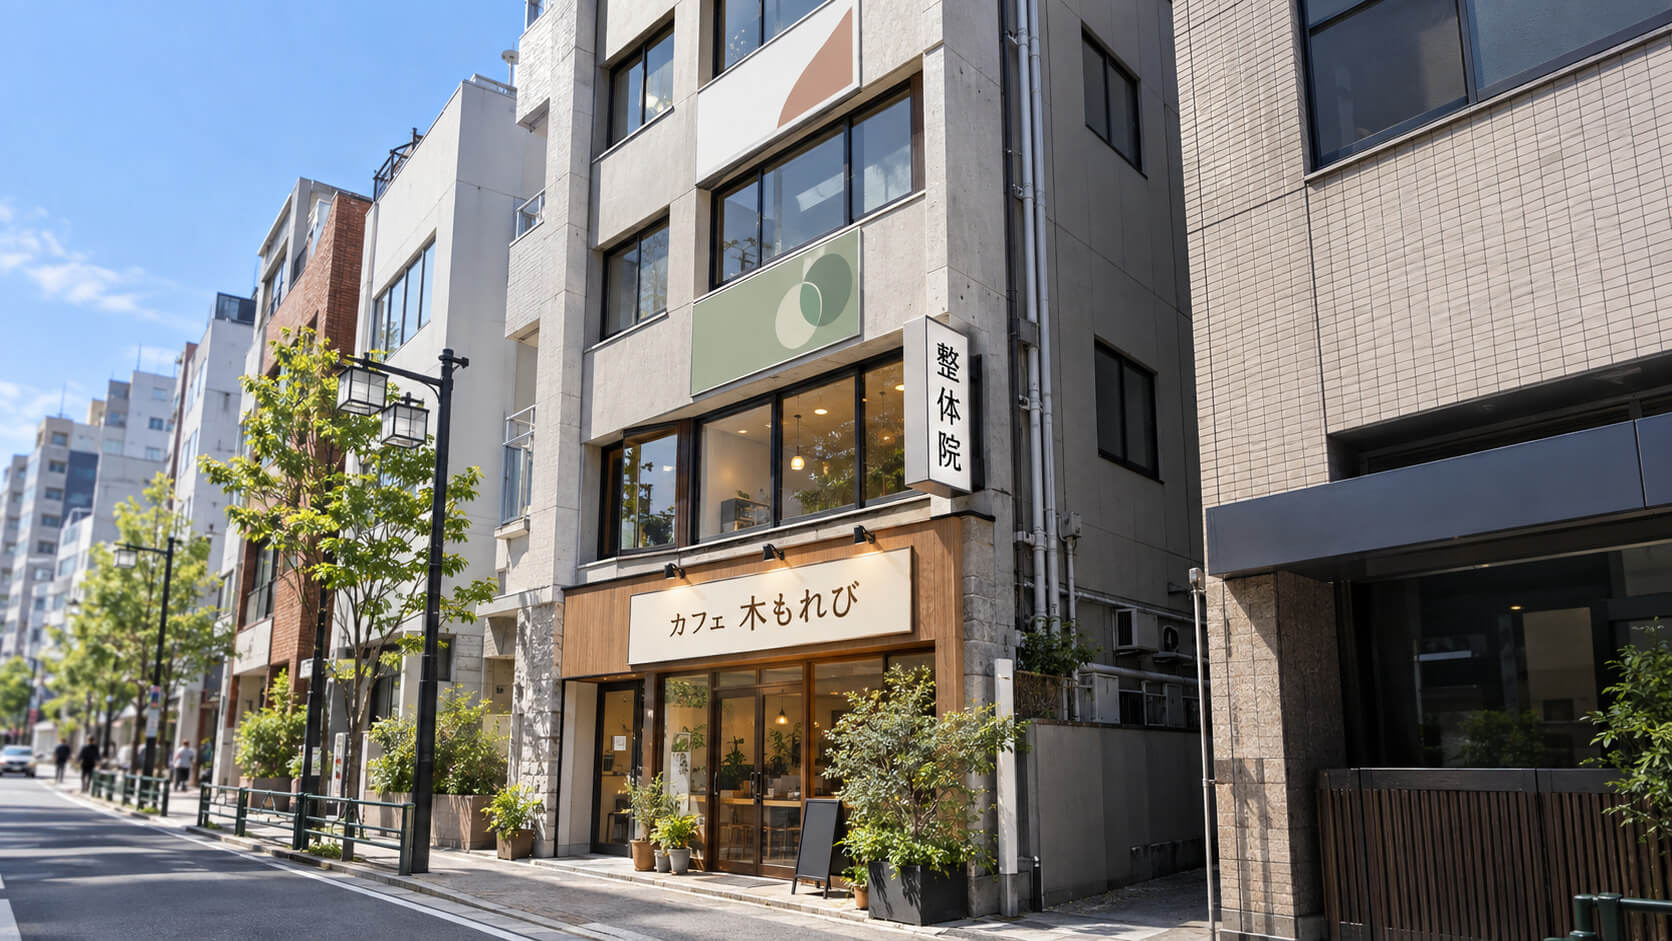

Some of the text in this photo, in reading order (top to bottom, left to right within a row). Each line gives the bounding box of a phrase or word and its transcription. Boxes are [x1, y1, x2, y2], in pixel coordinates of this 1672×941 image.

[936, 342, 962, 472] 整体院
[670, 580, 860, 637] カフェ 木もれび
